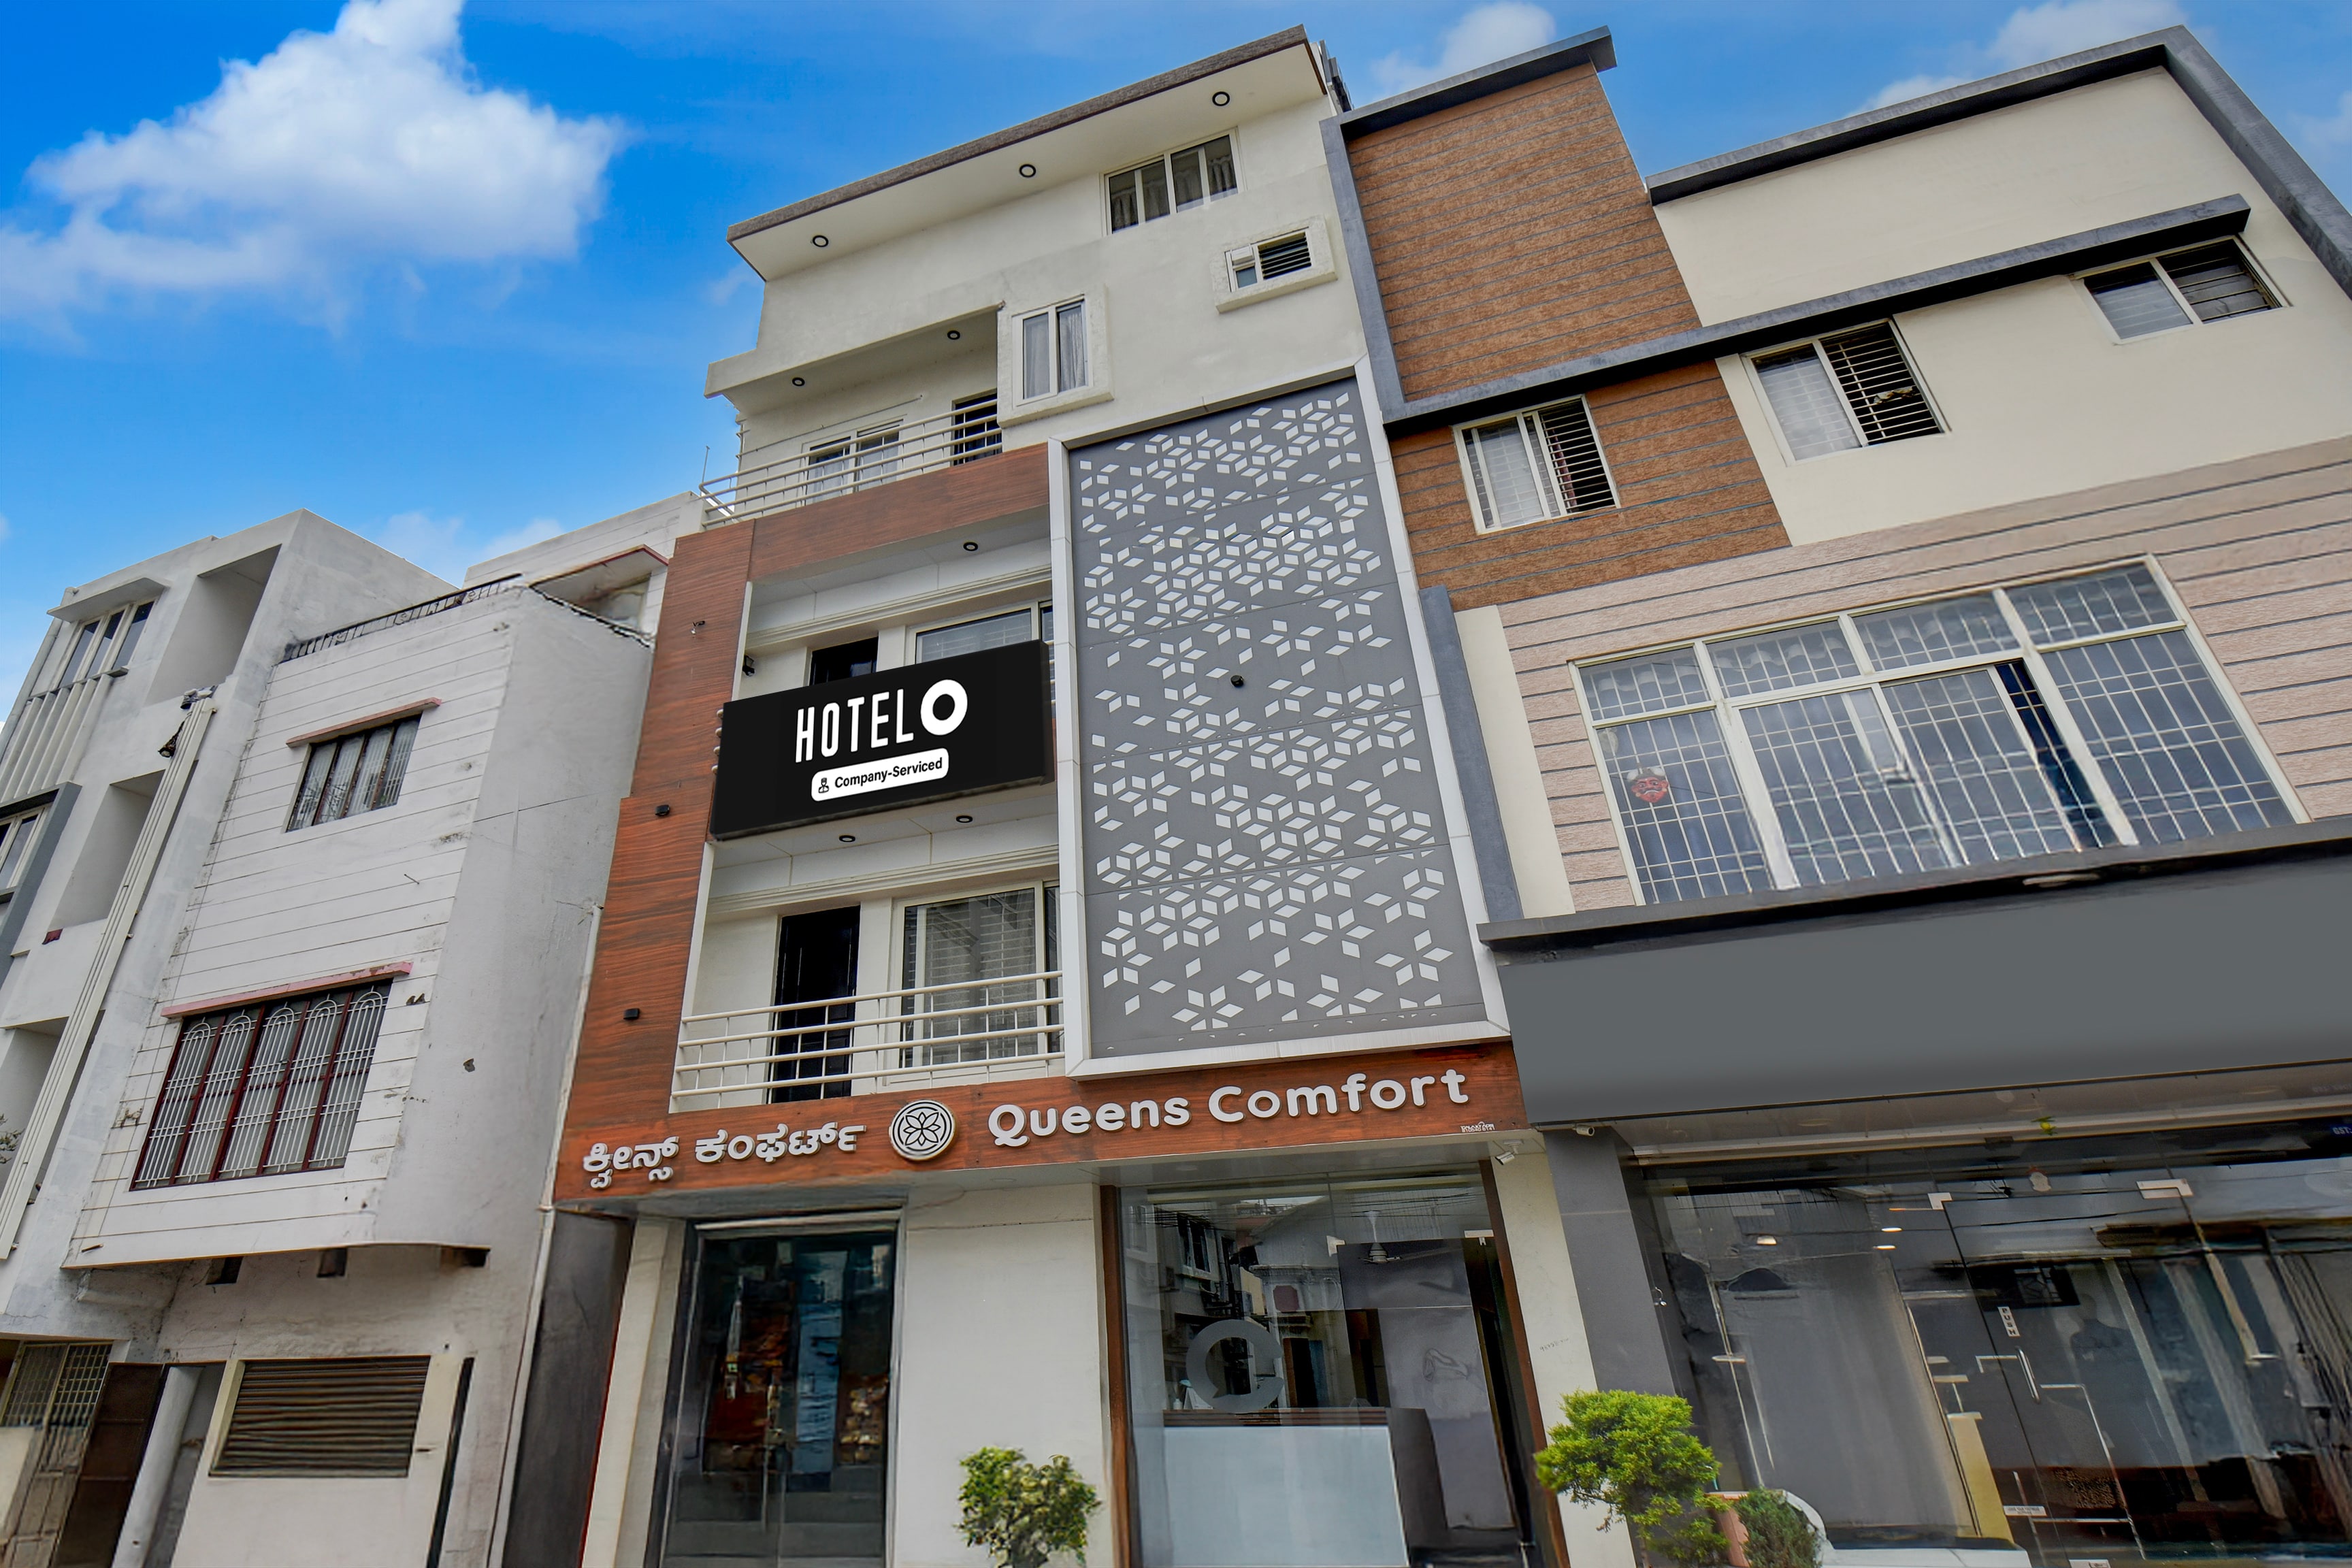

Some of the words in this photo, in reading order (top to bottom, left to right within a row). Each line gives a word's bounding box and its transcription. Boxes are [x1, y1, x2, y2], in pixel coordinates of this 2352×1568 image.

[795, 689, 914, 763] HOTEL
[920, 679, 968, 736] O
[834, 757, 943, 789] Company-Serviced
[987, 1096, 1192, 1147] Queens
[1208, 1068, 1470, 1123] Comfort
[2002, 1307, 2016, 1335] PUSH
